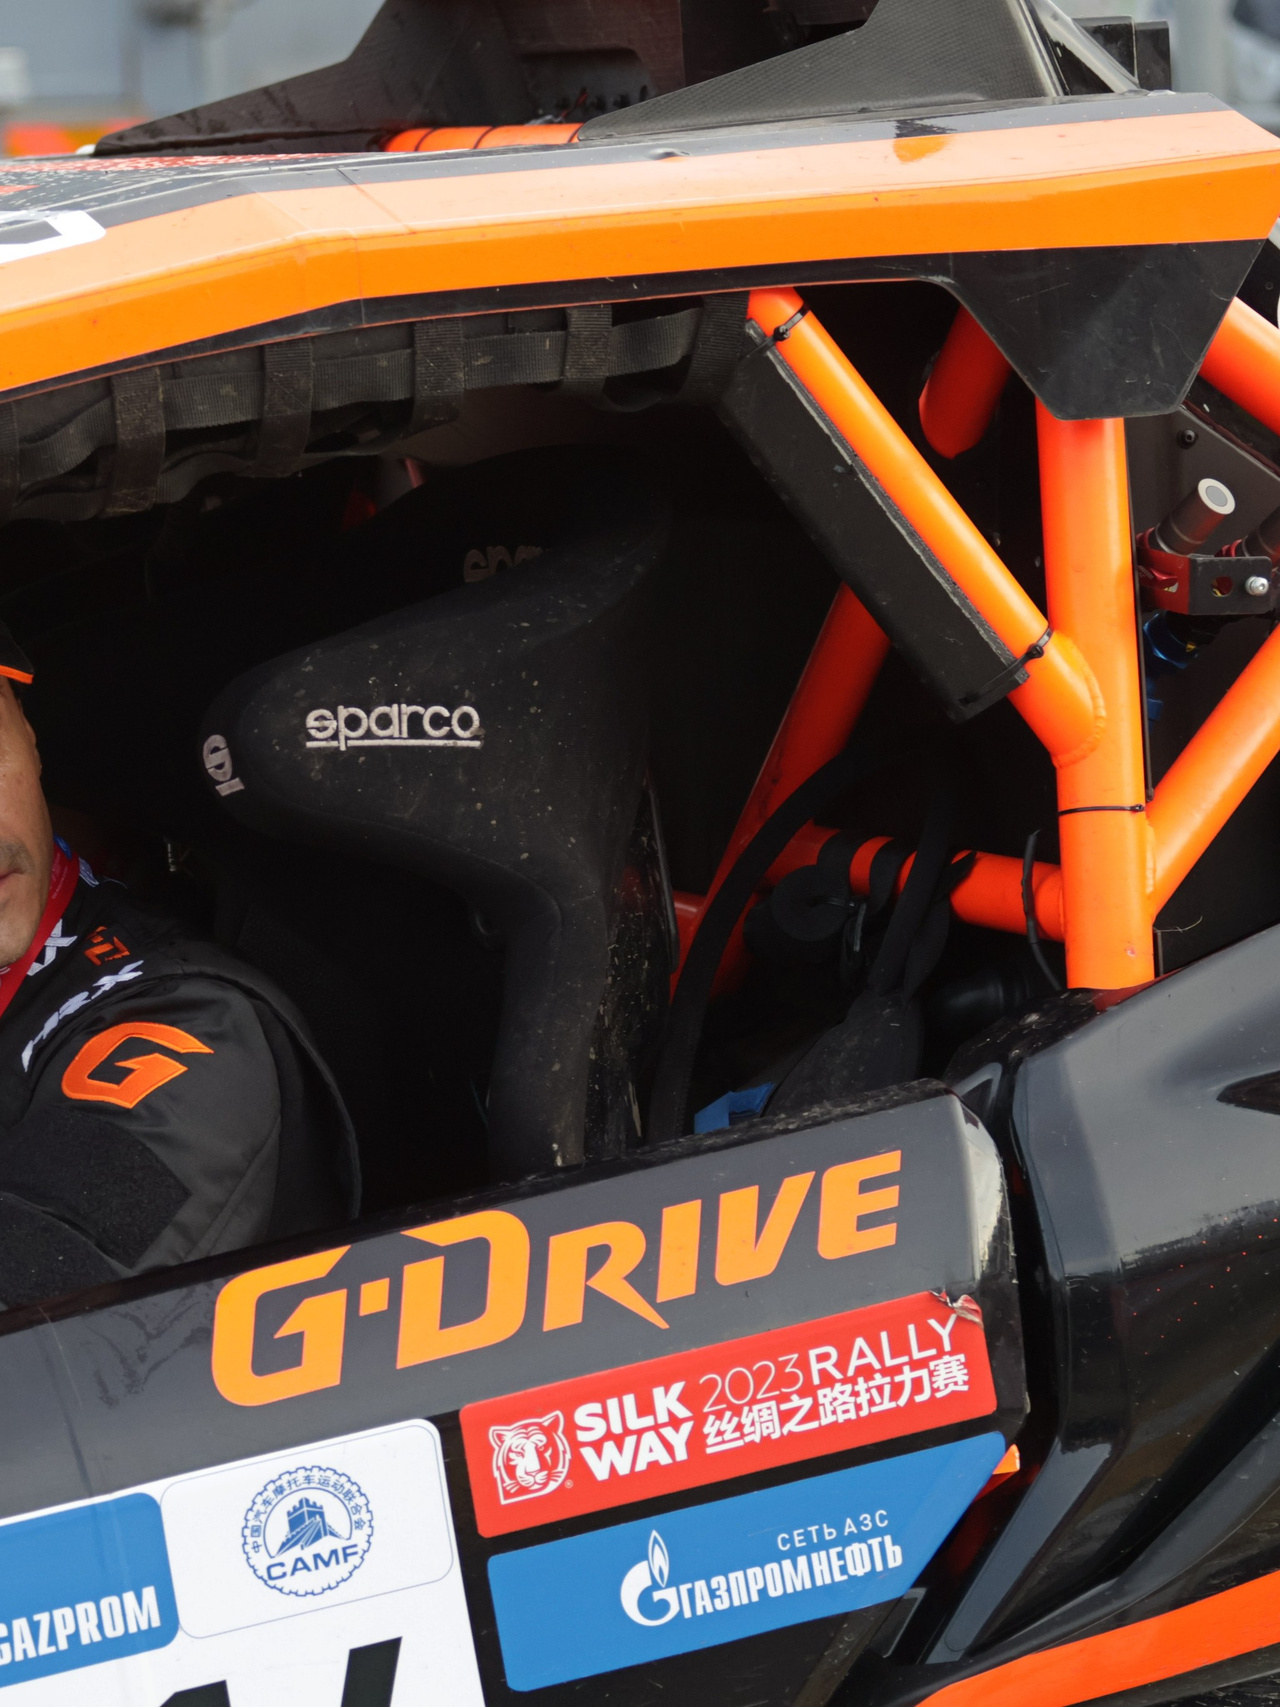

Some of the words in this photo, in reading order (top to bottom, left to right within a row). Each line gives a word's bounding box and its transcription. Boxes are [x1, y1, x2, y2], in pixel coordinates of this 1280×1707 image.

[306, 703, 481, 751] sparco
[211, 1149, 903, 1407] G-DRIVE
[574, 1381, 693, 1442] SILK
[699, 1354, 804, 1414] 2023
[808, 1313, 959, 1385] RALLY
[703, 1354, 970, 1454] 丝绸之路拉力赛
[580, 1421, 694, 1481] WAY
[266, 1543, 359, 1581] CAMF
[777, 1522, 838, 1551] СЕТЬ
[843, 1510, 889, 1536] АЗС
[678, 1534, 903, 1619] ГАЗПРОМНЕФТЬ
